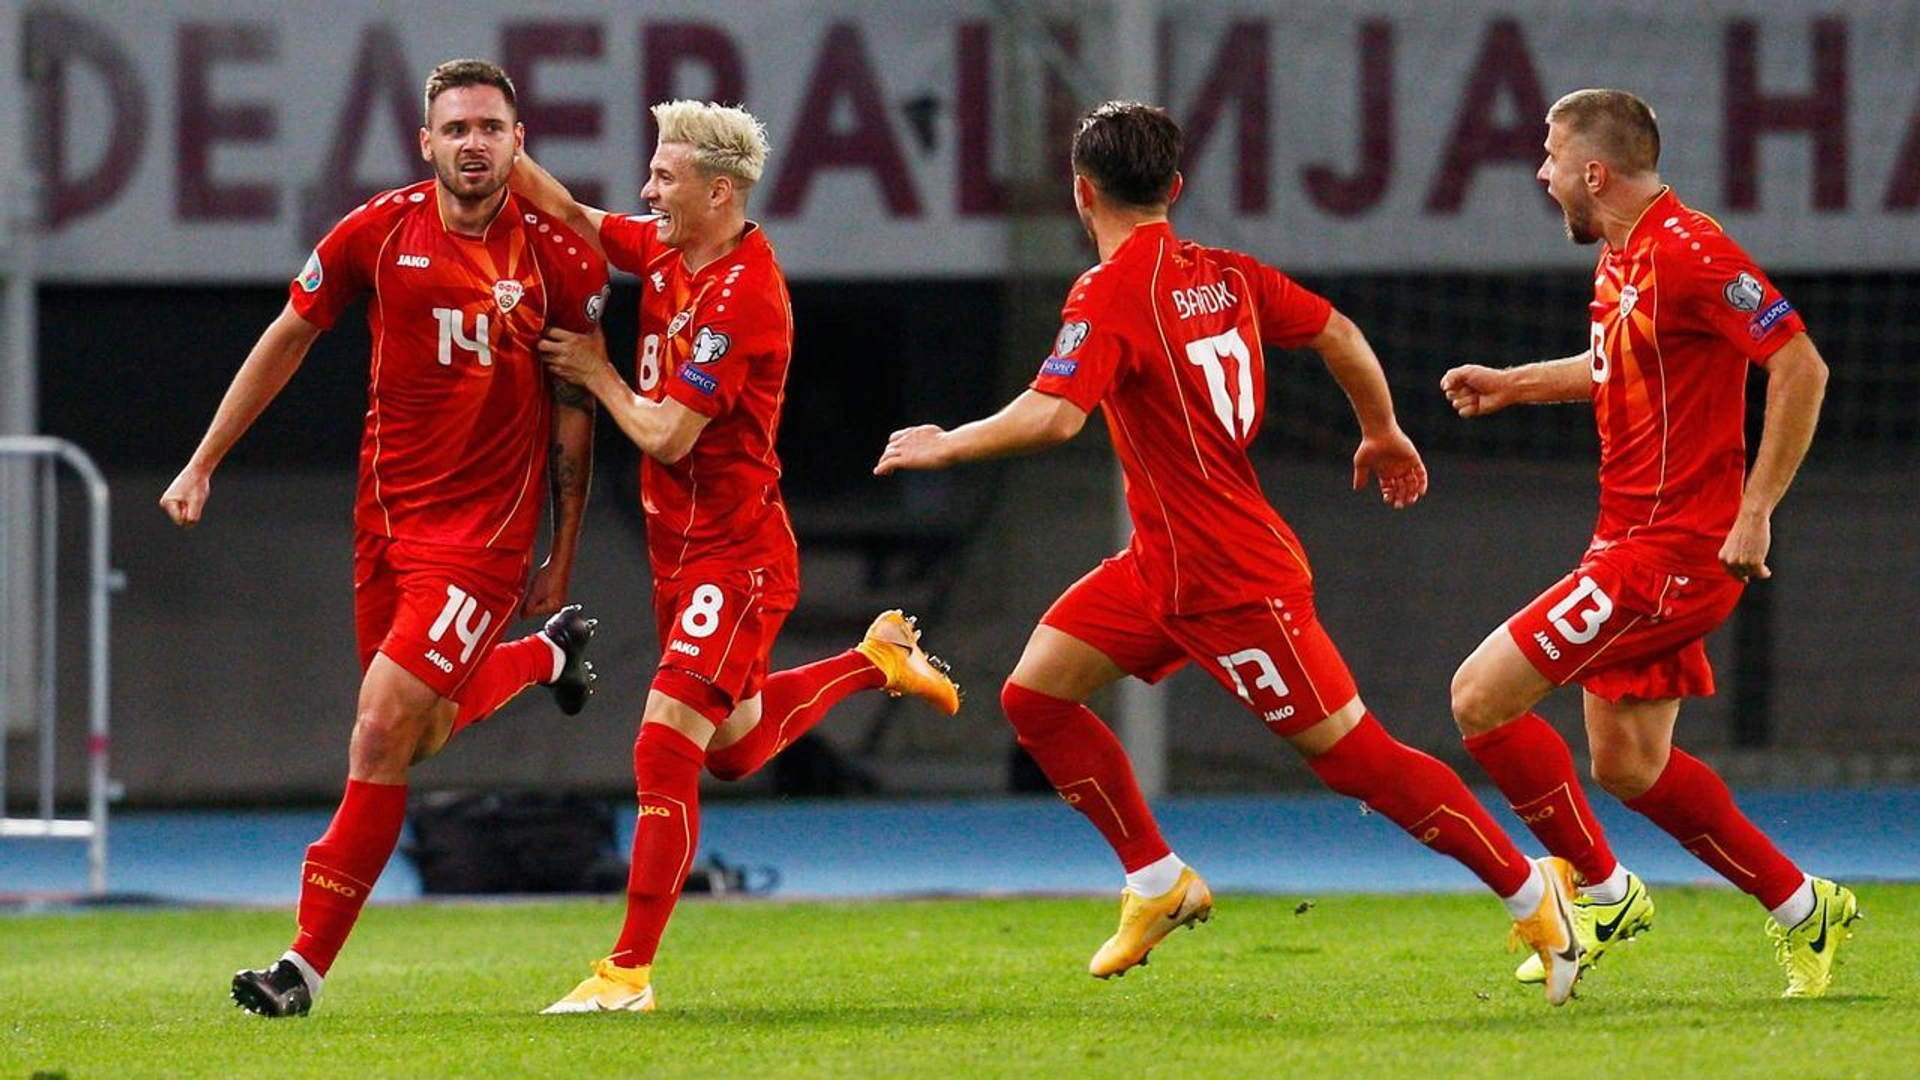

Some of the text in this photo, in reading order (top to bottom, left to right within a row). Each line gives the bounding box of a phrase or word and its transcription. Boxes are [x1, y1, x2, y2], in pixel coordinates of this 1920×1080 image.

[1723, 16, 1920, 215] Н
[396, 254, 430, 268] JAKO
[1759, 301, 1790, 327] RESPECT
[432, 307, 492, 366] 14
[639, 333, 660, 392] 8
[683, 369, 717, 390] RESPECT
[428, 584, 492, 664] 14
[681, 583, 724, 638] 8
[1546, 575, 1614, 645] 13
[669, 639, 700, 657] JAKO
[1533, 630, 1561, 660] JAKO
[424, 649, 453, 673] JAKO
[1216, 648, 1290, 705] 17
[1263, 705, 1295, 722] JAKO
[307, 872, 356, 898] JAKO
